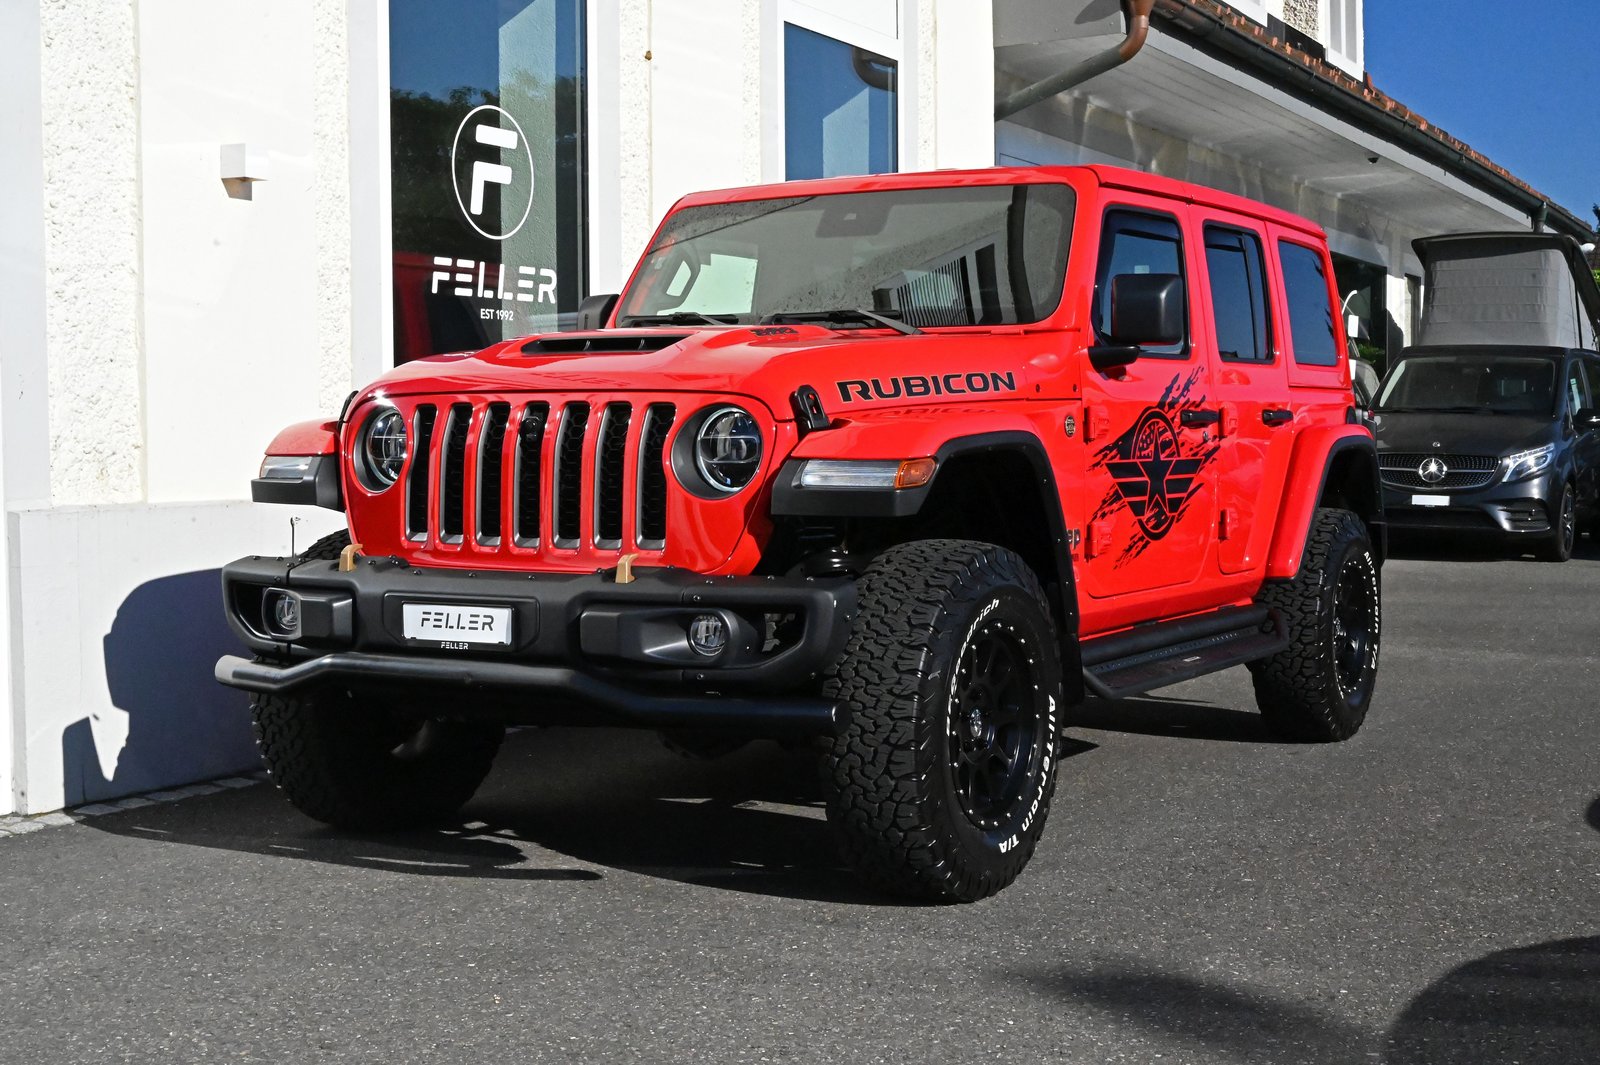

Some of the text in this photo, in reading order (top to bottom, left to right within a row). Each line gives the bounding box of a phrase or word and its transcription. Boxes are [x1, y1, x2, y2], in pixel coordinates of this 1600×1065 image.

[470, 124, 518, 215] F
[431, 256, 557, 304] FELLER
[480, 308, 514, 321] EST 1992
[836, 371, 1016, 403] RUBICON
[421, 611, 494, 632] FELLER
[440, 641, 469, 650] FELLER
[998, 833, 1020, 854] T/A
